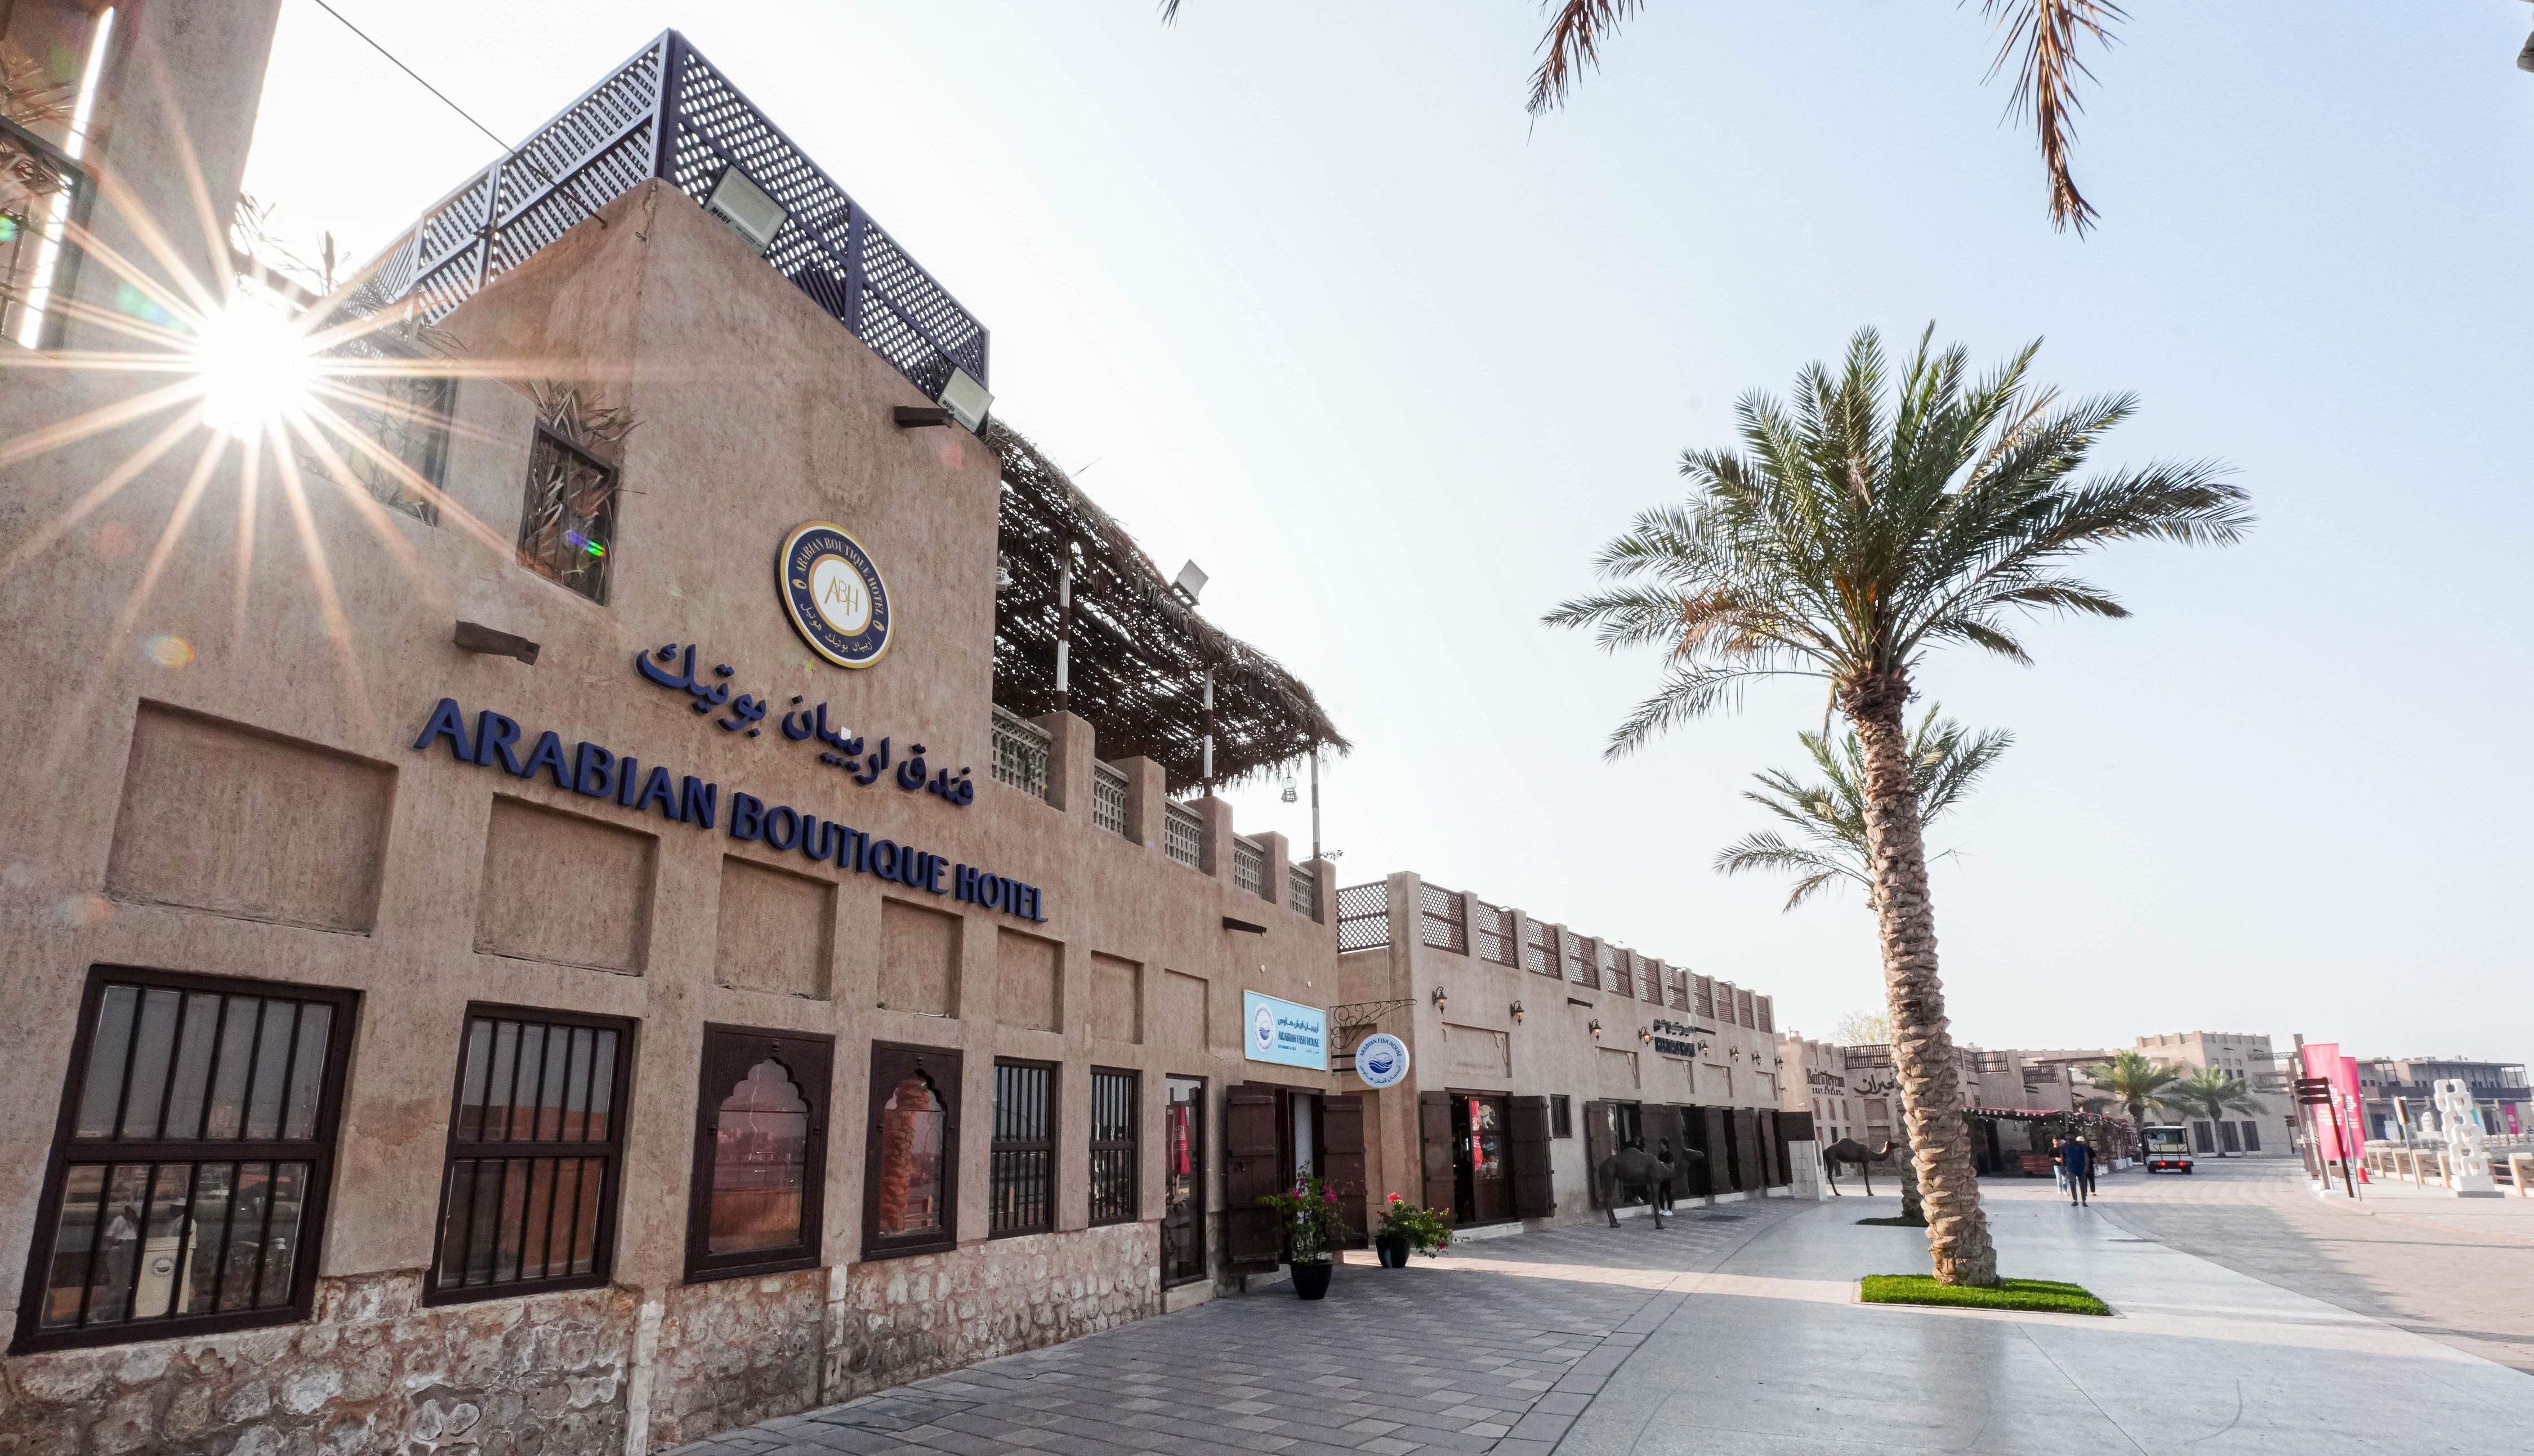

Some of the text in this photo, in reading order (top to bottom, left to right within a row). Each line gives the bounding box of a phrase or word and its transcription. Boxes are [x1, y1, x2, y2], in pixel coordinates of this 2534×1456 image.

[796, 537, 884, 615] ARABIAN BOUTIQUE HOTEL
[636, 642, 767, 739] بوتيك
[896, 742, 974, 806] فندق
[412, 697, 1049, 923] ARABIAN BOUTIQUE HOTEL
[1278, 1031, 1297, 1043] ARABIAN
[1297, 1034, 1306, 1044] FISH
[1306, 1037, 1320, 1048] HOUSE
[1360, 1038, 1377, 1057] ARABIAN
[1389, 1041, 1402, 1057] HOUSE
